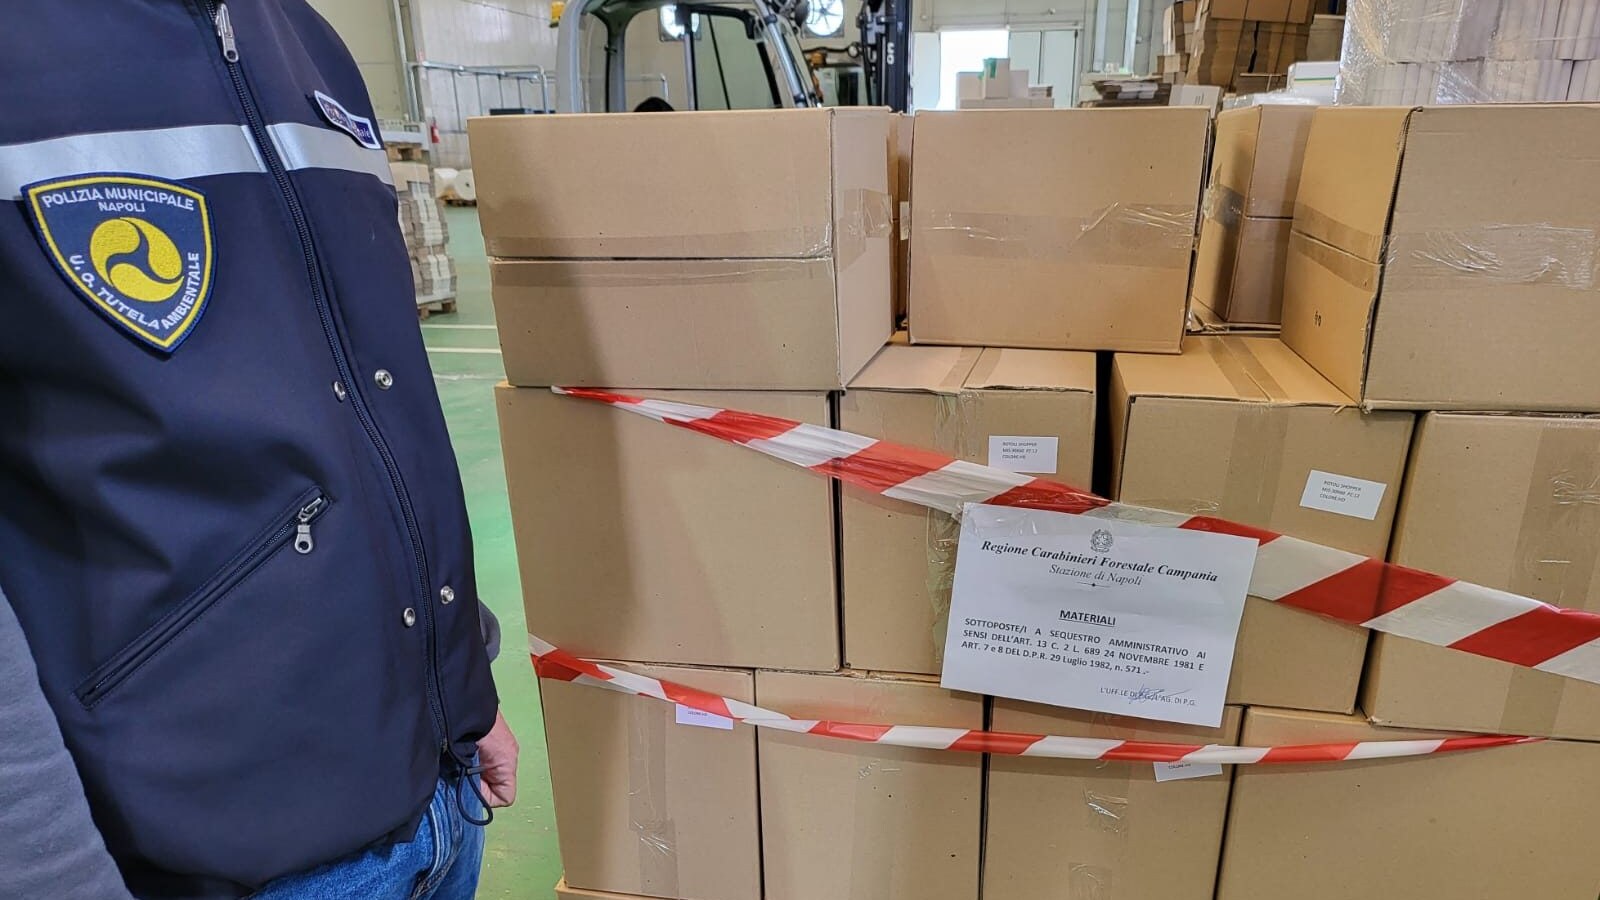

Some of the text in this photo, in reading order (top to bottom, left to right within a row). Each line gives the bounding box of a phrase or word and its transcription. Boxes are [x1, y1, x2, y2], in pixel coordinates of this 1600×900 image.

[42, 187, 194, 211] POLIZIA MUNICIPALE
[98, 201, 146, 212] NAPOLI
[97, 287, 160, 330] TUTELA
[160, 252, 200, 330] AMBIENTALE
[981, 540, 1218, 582] Regione Carabinieri Forestale Campania
[1049, 564, 1143, 586] Stazione di Napoli
[1059, 610, 1116, 626] MATERIALI
[963, 629, 1204, 671] SENSI DELL'ART. 13 C. 2 L. 689 24 NOVEMBRE 1981 E
[964, 617, 1206, 660] SOTTOPOSTE/I A SEQUESTRO AMMINISTRATIVO AI
[961, 641, 981, 651] ART.
[1005, 647, 1021, 656] DEL
[1022, 649, 1048, 660] D.P.R.
[1050, 654, 1061, 662] 29
[1062, 656, 1087, 667] Luglio
[1090, 660, 1113, 671] 1982,
